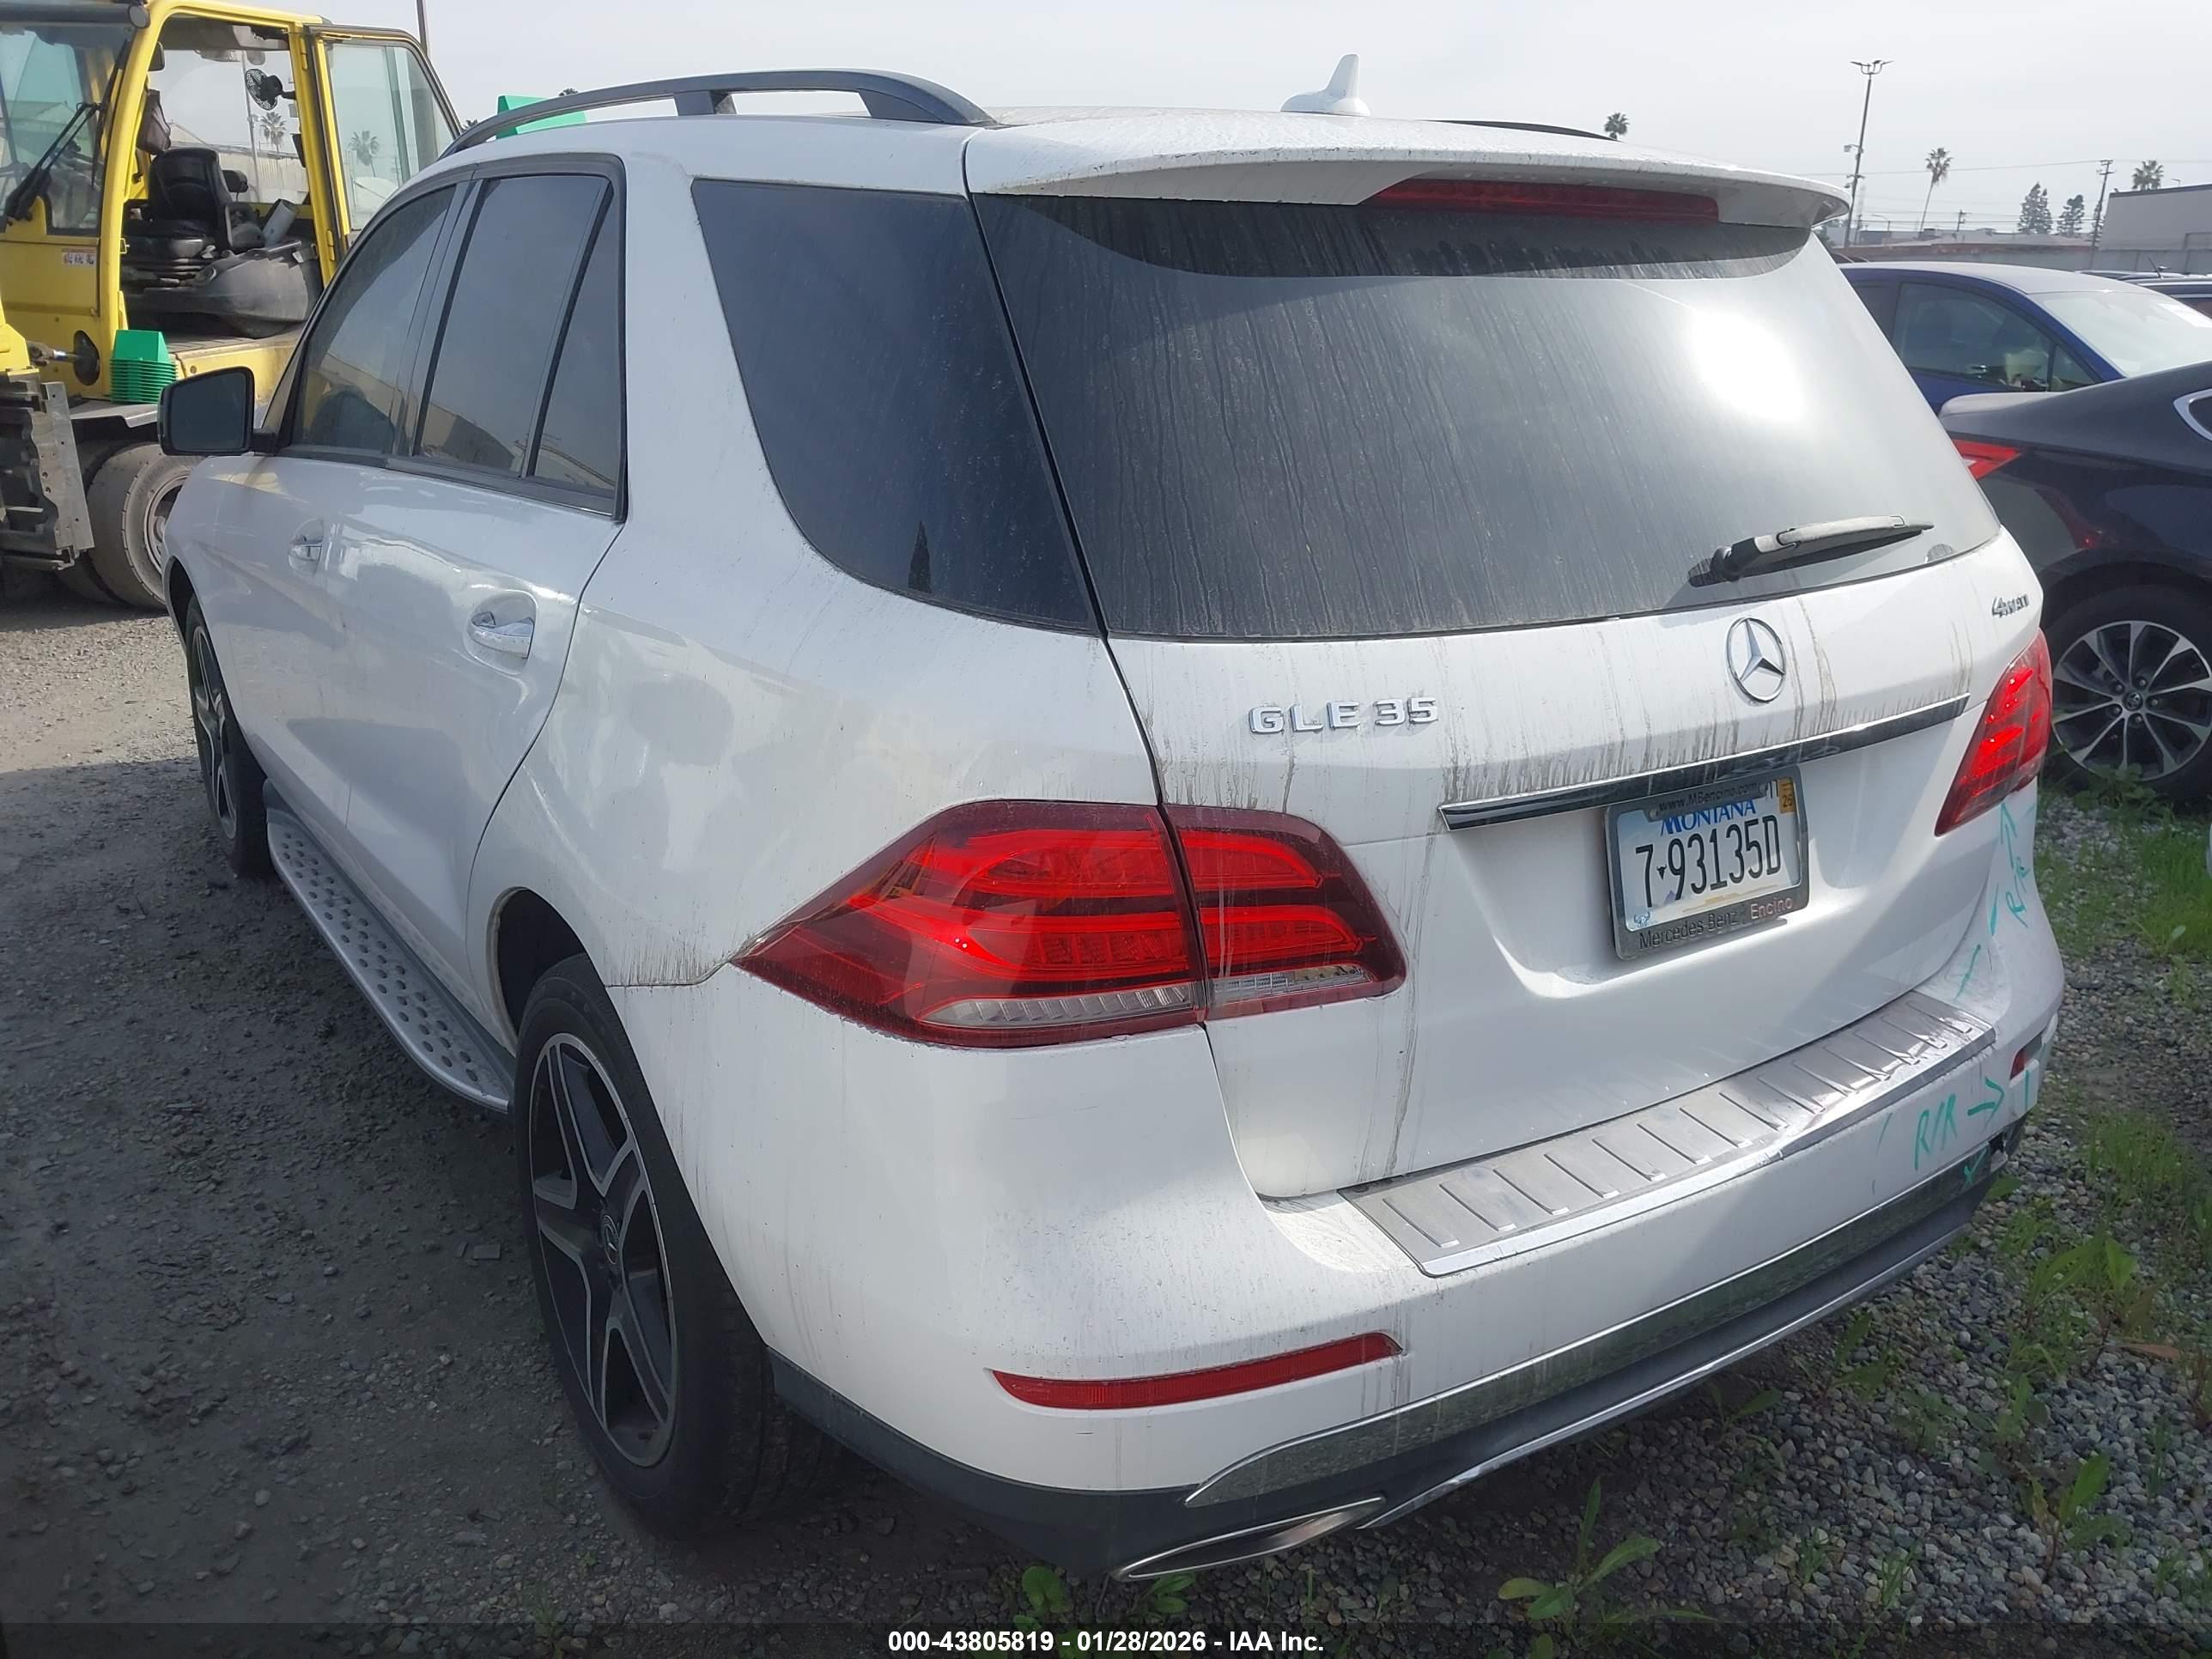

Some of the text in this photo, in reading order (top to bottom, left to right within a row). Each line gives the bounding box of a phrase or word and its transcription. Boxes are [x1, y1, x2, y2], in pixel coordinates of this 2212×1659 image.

[1249, 696, 1438, 734] GLE 35
[1661, 799, 1756, 836] MONTANA
[1750, 897, 1793, 920] Encino
